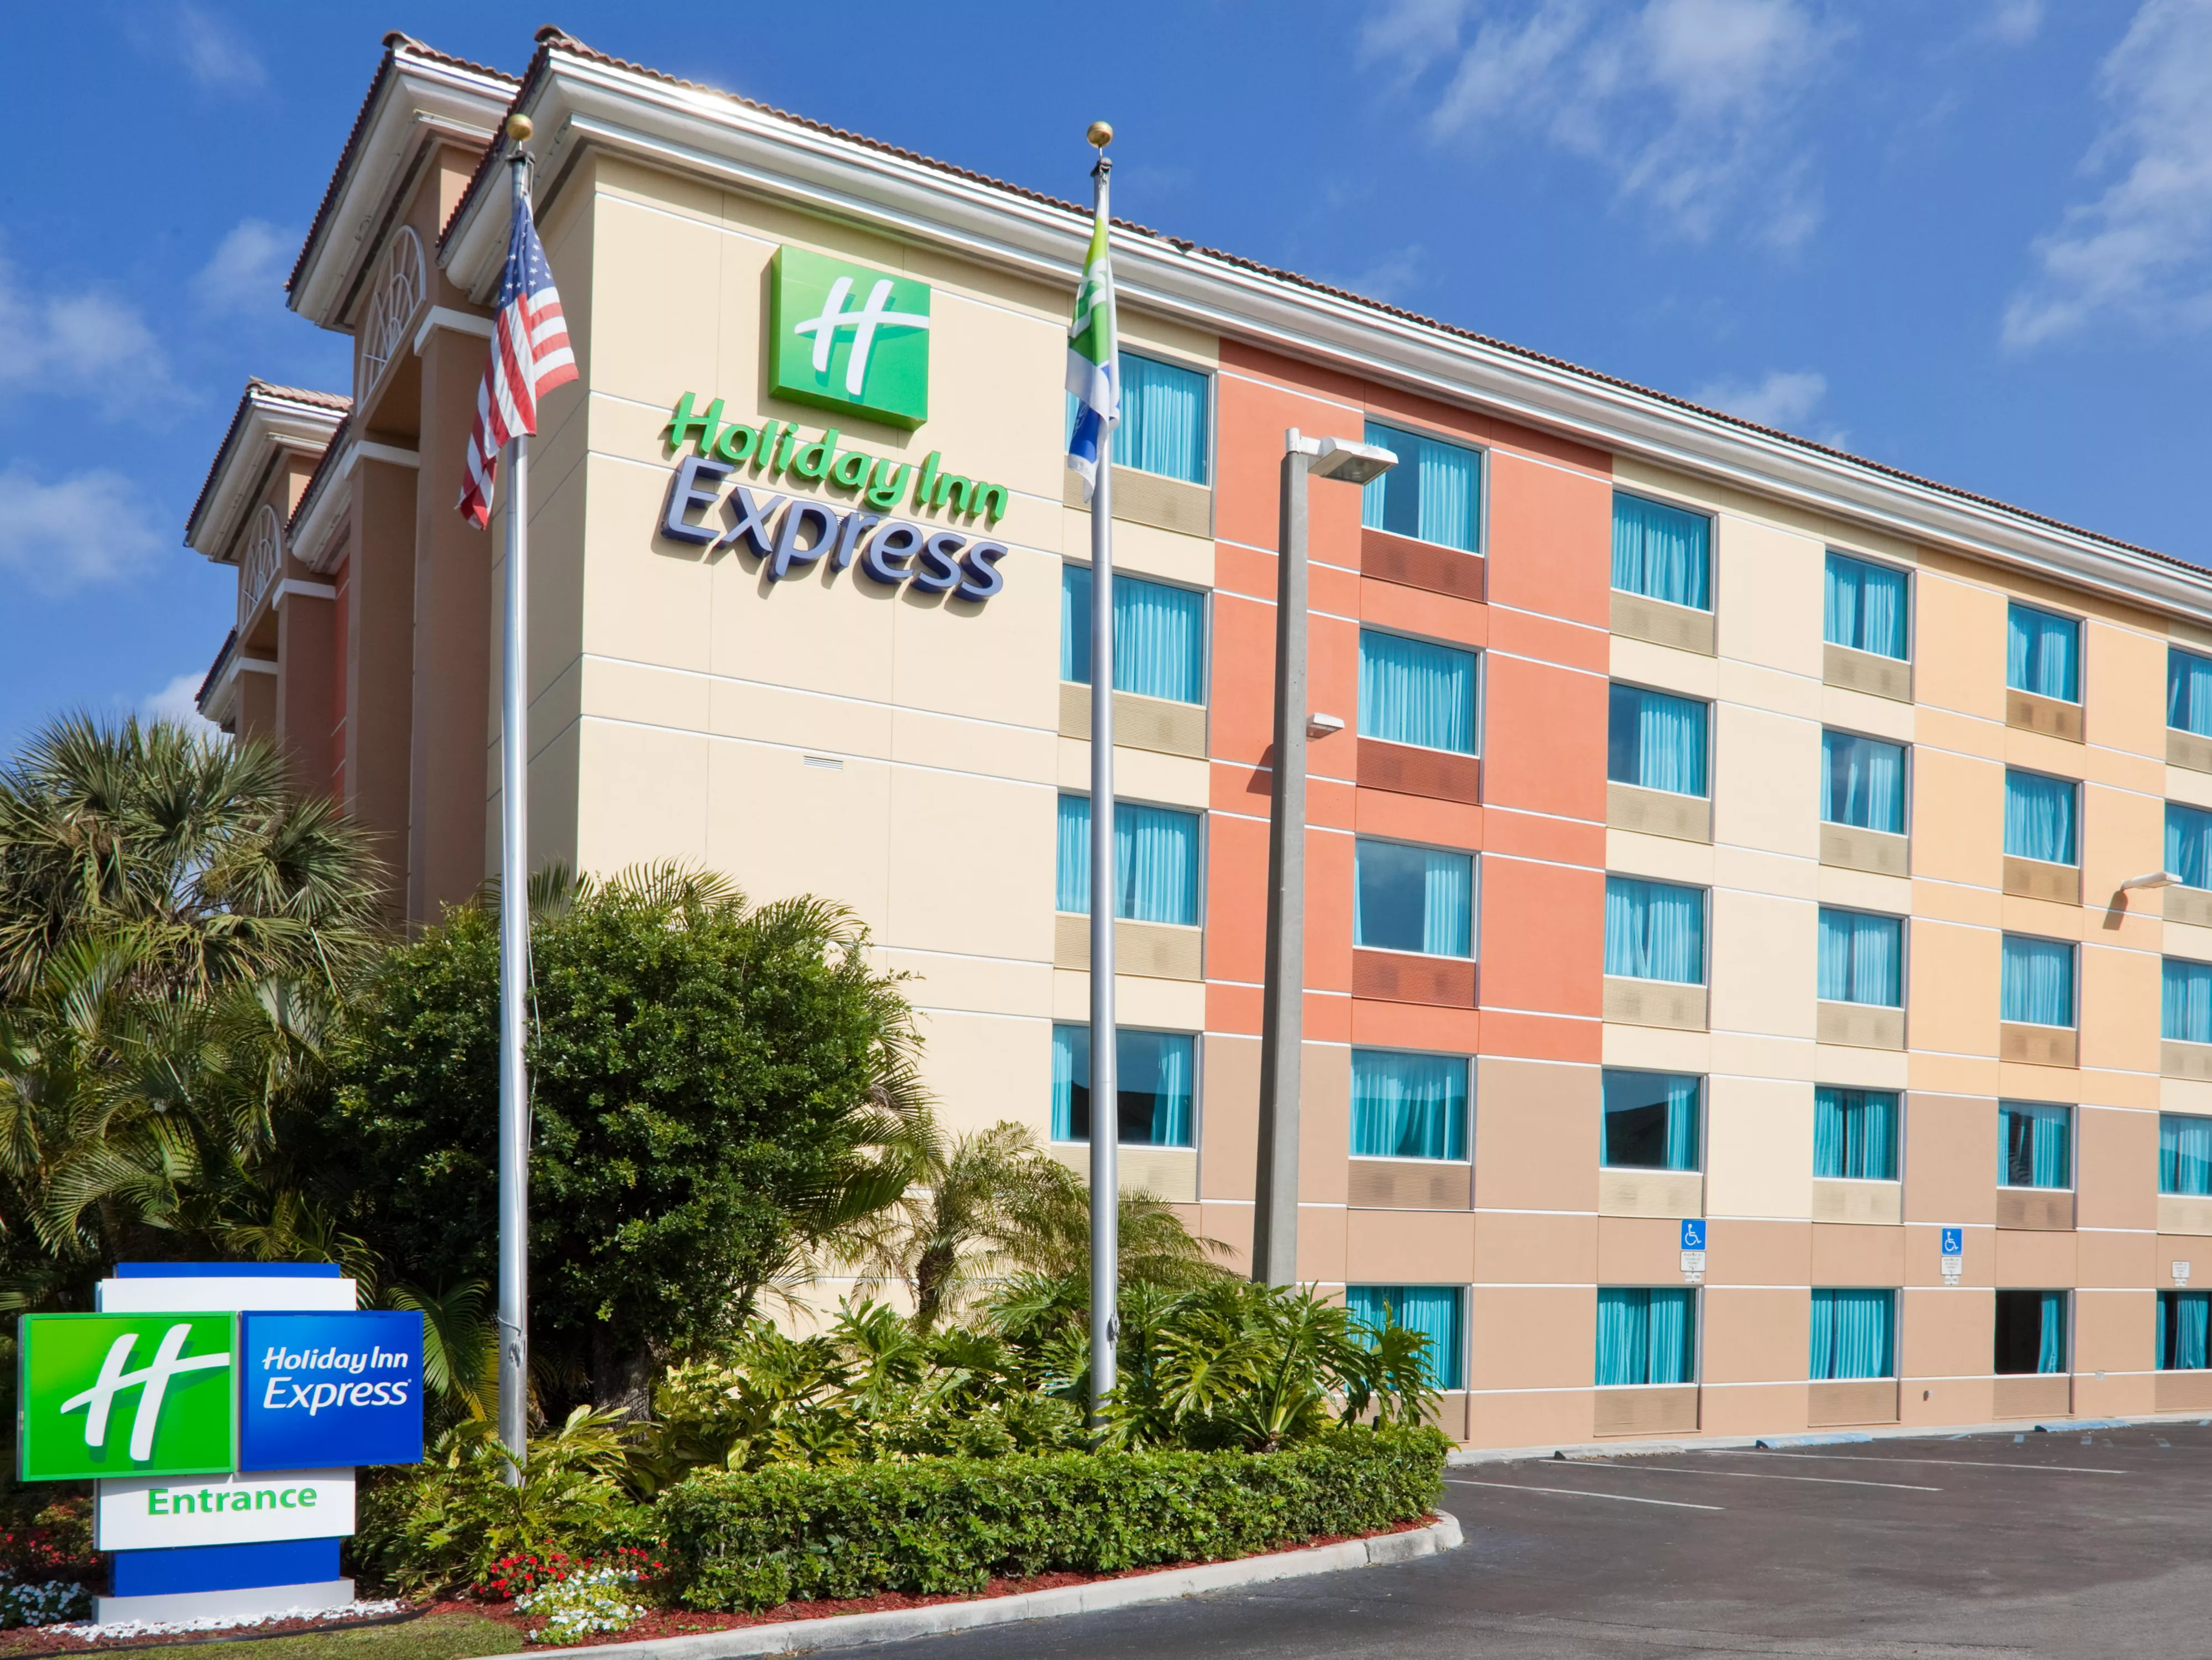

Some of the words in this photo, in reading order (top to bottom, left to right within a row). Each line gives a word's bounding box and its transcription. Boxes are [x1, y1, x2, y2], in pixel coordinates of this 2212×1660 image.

[667, 391, 912, 511] Holiday
[916, 450, 1008, 523] Inn
[661, 455, 1008, 603] Express
[262, 1346, 368, 1374] Holiday
[371, 1346, 408, 1368] Inn
[263, 1377, 409, 1416] Express
[148, 1487, 317, 1516] Entrance
